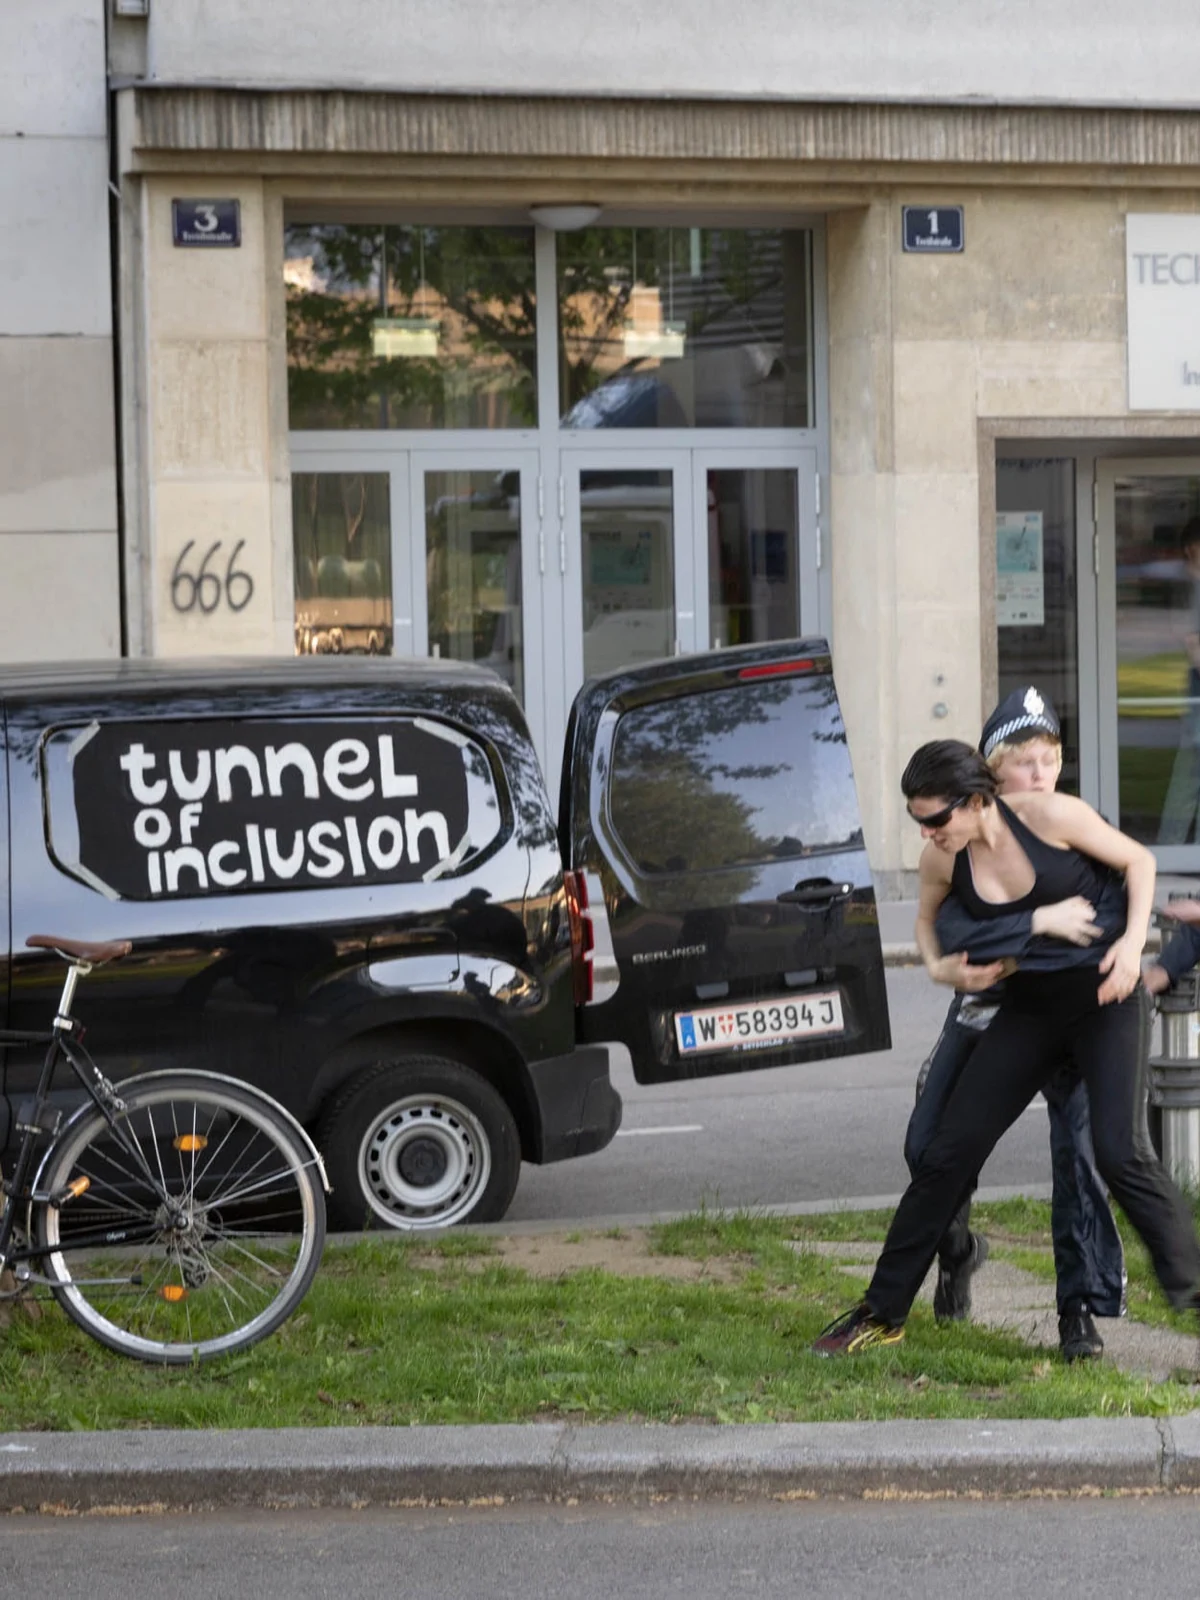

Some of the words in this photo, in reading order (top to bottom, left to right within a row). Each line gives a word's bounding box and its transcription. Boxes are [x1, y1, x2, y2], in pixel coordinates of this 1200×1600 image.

[193, 204, 219, 232] 3
[927, 210, 939, 235] 1
[171, 539, 254, 615] 666
[631, 944, 708, 965] BERLINGO
[698, 1015, 717, 1043] W
[735, 1003, 815, 1036] 58394
[818, 1000, 835, 1026] J
